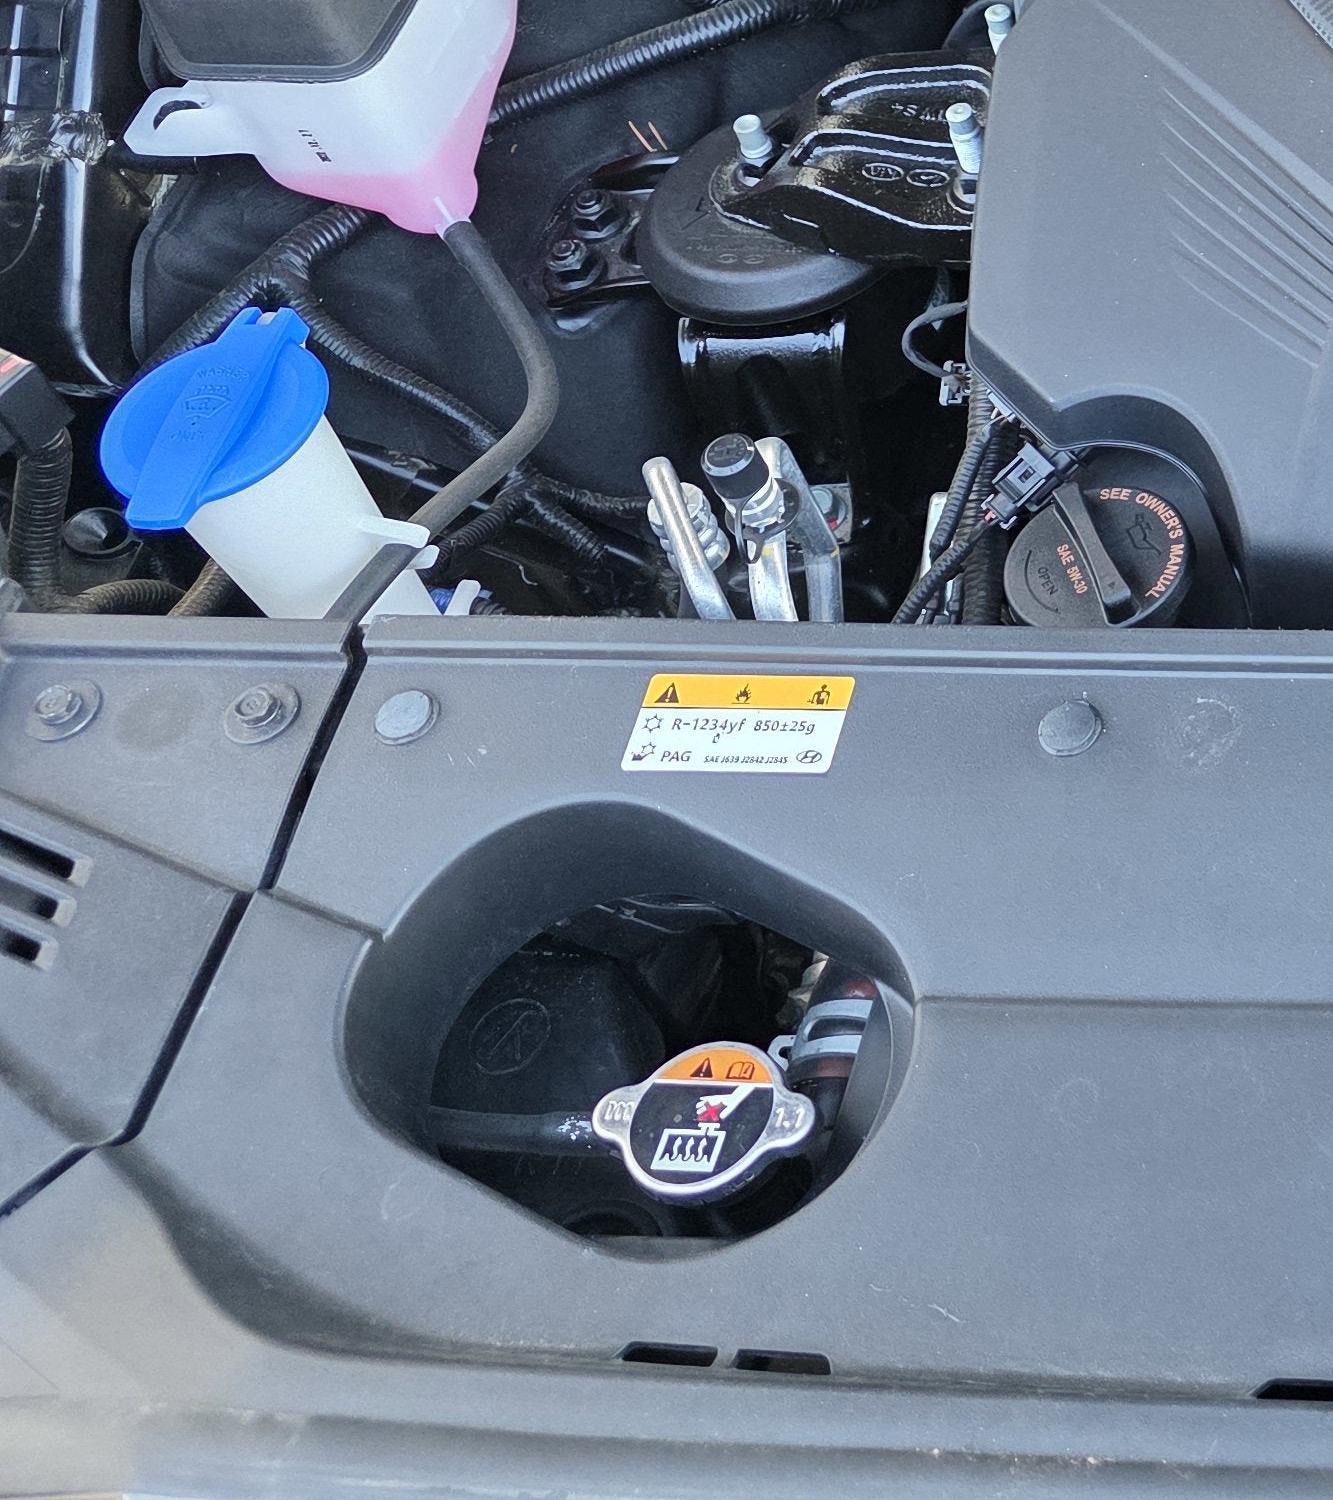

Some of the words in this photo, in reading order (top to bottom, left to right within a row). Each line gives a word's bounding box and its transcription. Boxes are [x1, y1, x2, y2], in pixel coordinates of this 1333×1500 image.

[1099, 487, 1132, 501] SEE
[1135, 492, 1184, 540] OWNER'S
[1056, 543, 1075, 566] SAE
[1037, 566, 1060, 596] OPEN
[1144, 543, 1185, 599] MANUAL
[671, 718, 746, 734] R-1234yf
[753, 719, 816, 735] 850±25g
[660, 750, 692, 763] PAG
[703, 755, 720, 764] SAE
